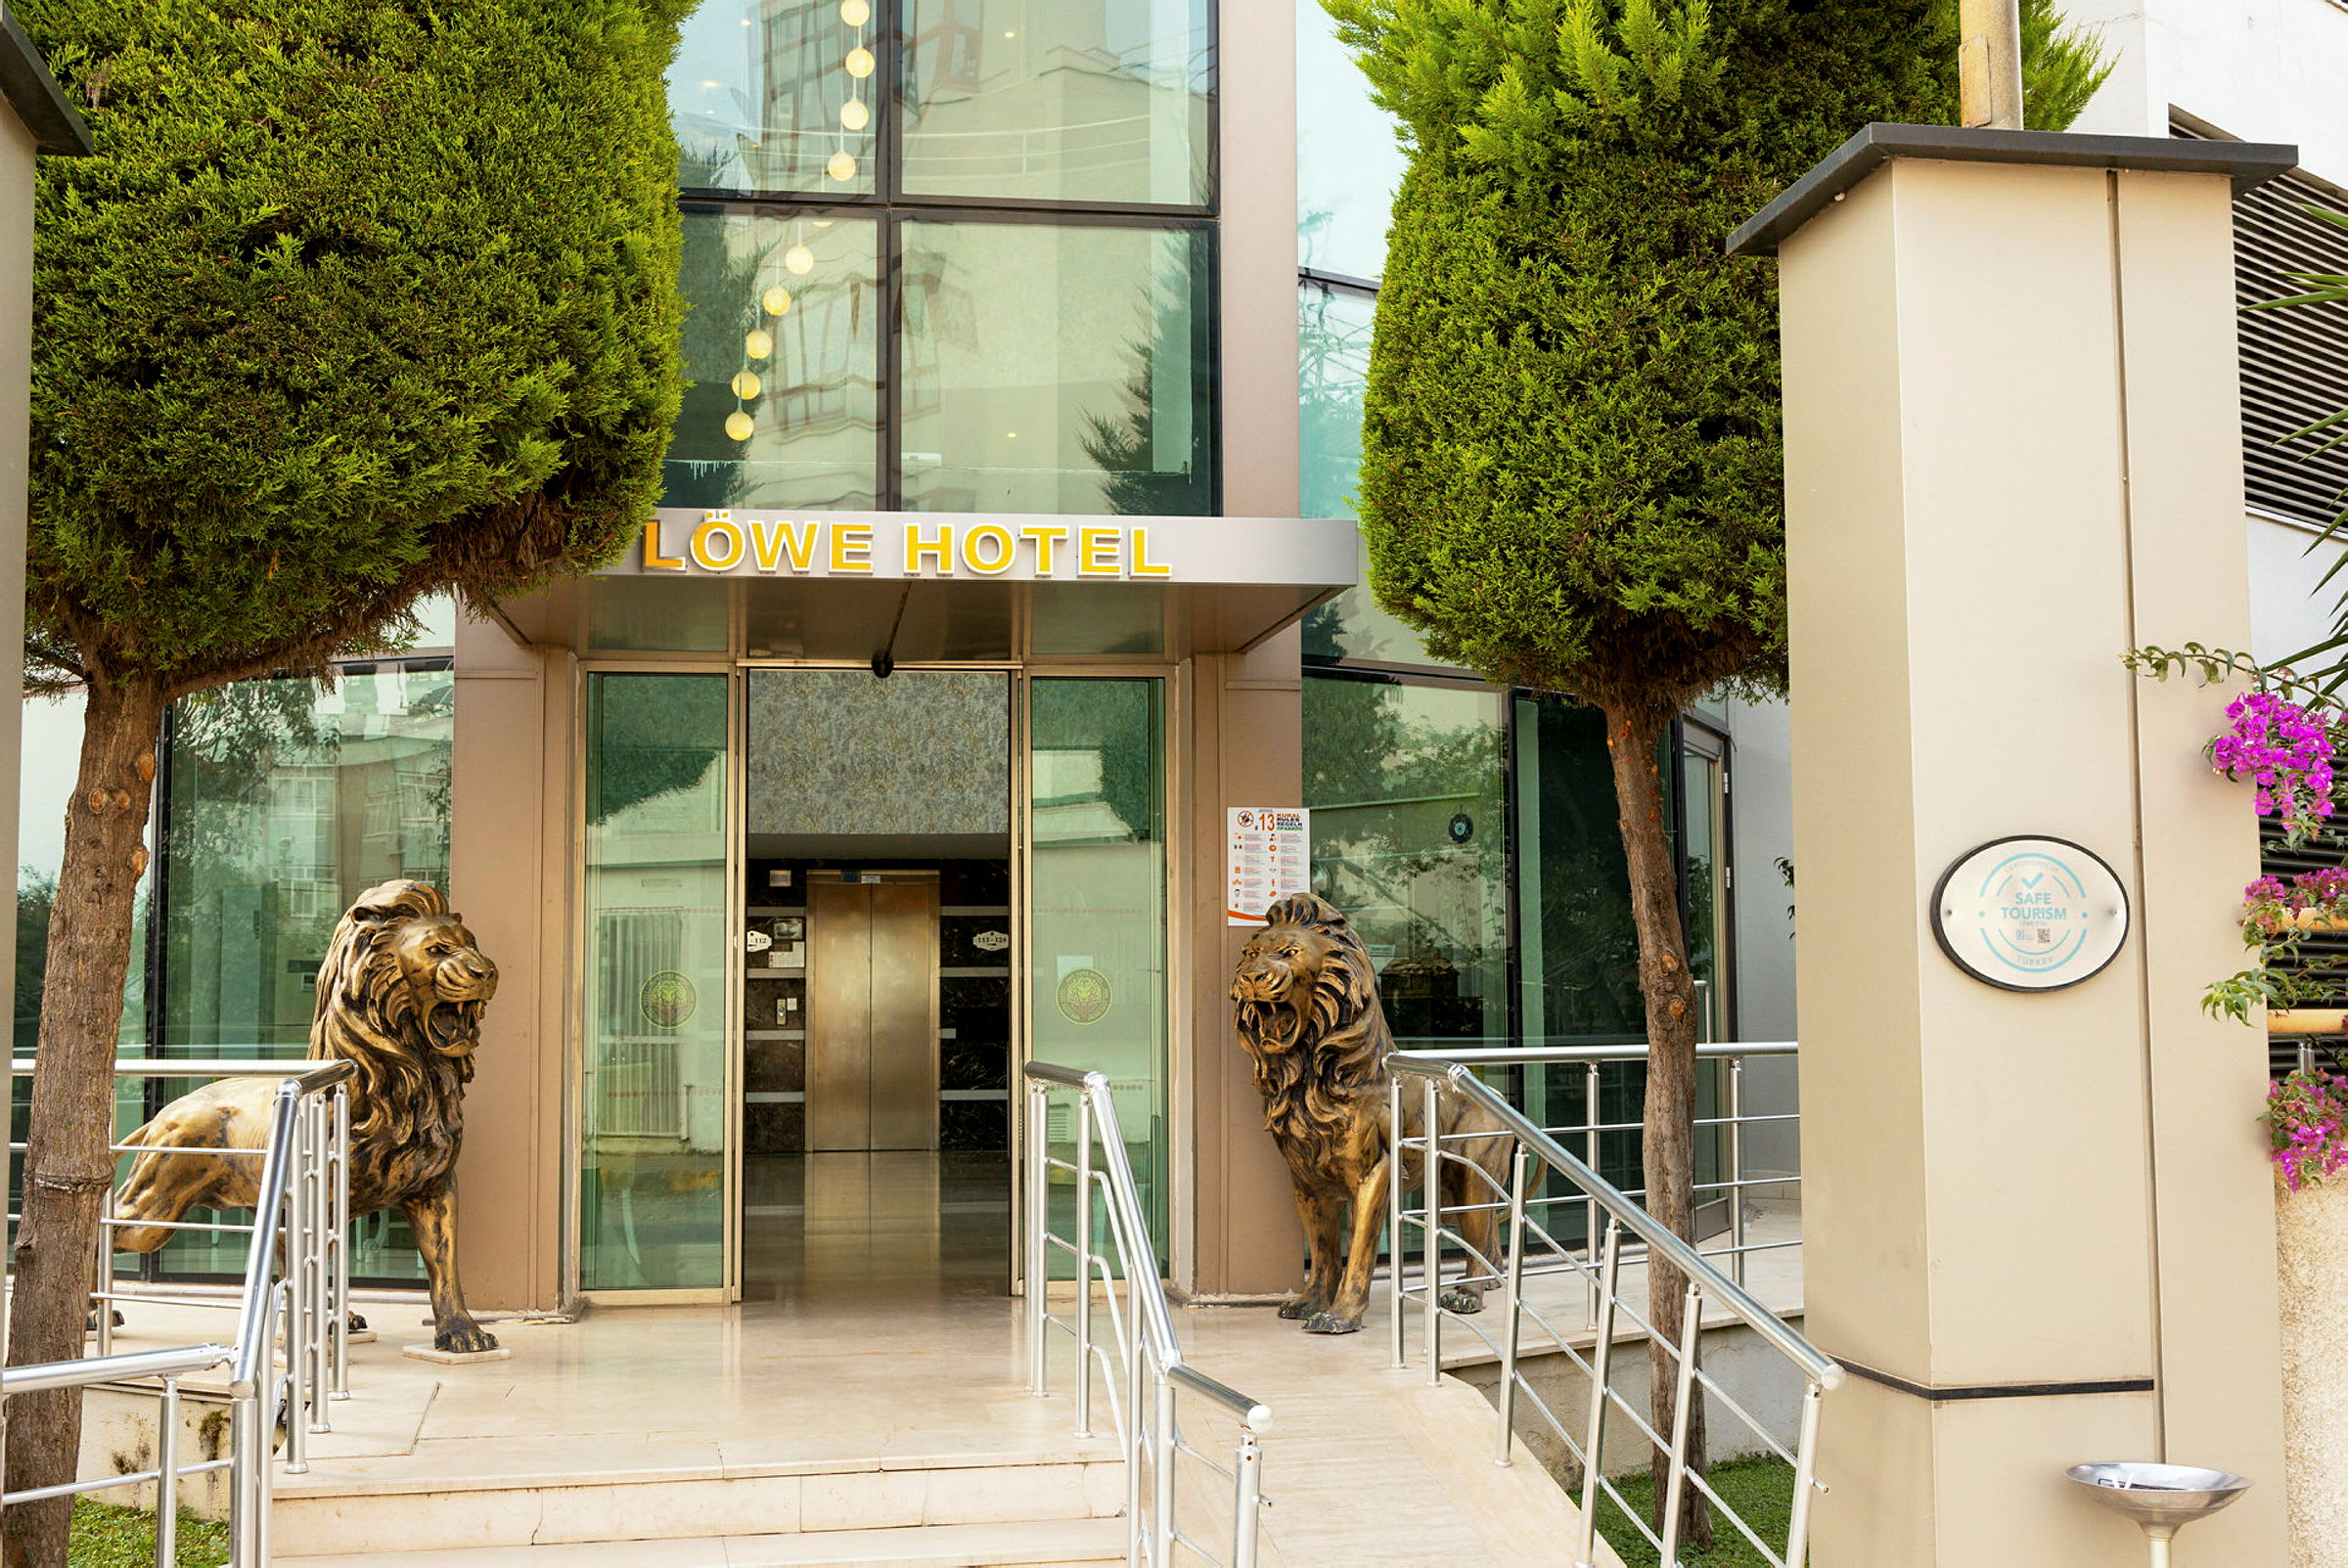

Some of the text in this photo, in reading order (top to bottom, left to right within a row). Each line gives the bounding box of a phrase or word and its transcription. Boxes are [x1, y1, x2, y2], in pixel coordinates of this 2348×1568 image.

[643, 510, 1172, 577] LÖWE HOTEL
[1259, 814, 1275, 831] 13
[2015, 892, 2052, 905] SAFE
[2001, 907, 2067, 920] TOURISM
